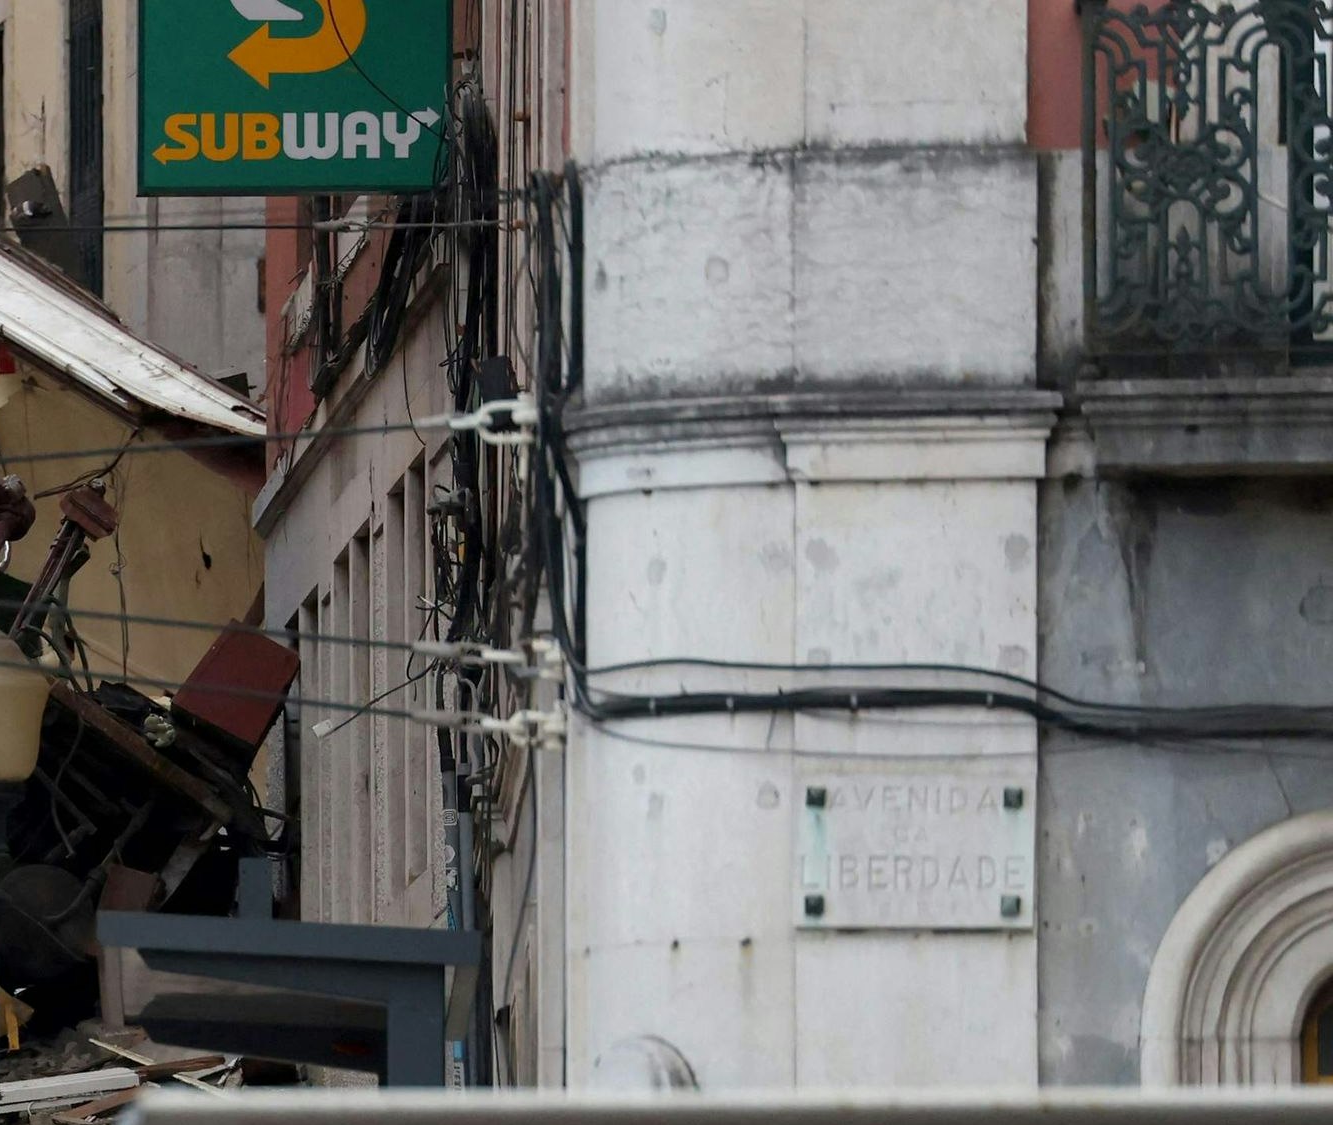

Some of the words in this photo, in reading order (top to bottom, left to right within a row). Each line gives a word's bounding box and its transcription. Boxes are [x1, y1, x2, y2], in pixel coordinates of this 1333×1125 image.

[152, 107, 441, 165] SUBWAY
[829, 786, 999, 813] AVENIDA
[799, 855, 1026, 891] LIBERDADE
